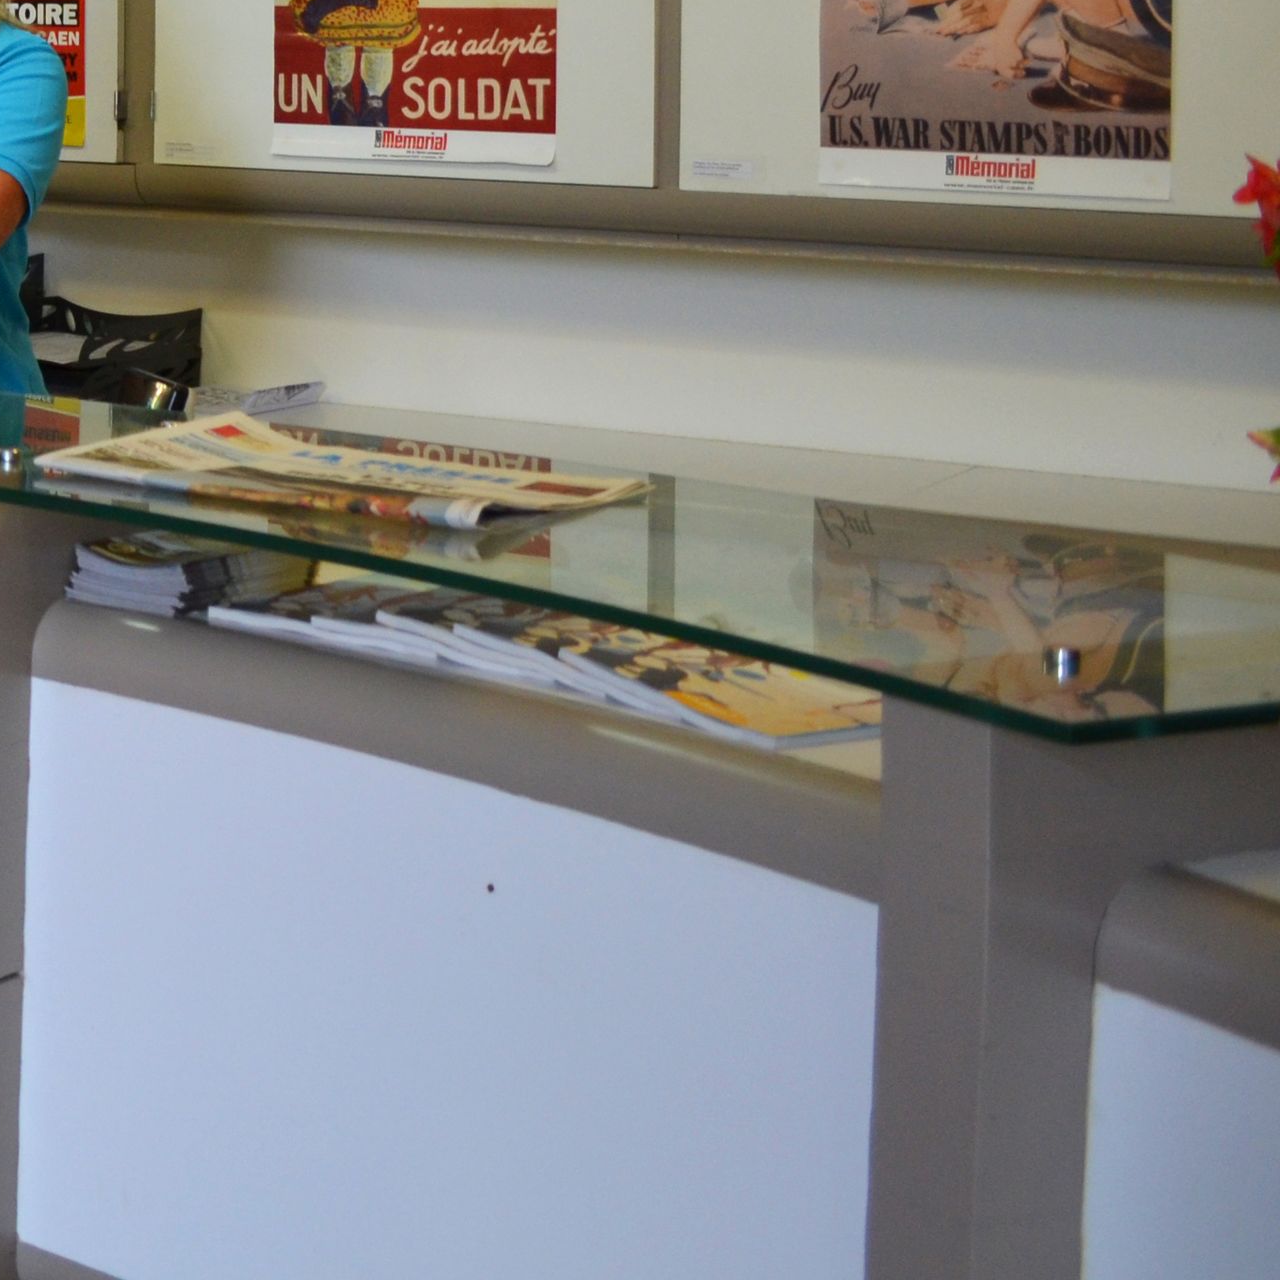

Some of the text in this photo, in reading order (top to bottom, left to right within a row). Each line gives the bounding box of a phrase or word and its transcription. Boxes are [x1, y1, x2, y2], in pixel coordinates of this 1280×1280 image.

[7, 3, 78, 25] TOIRE
[278, 73, 551, 121] UN SOLDAT
[820, 64, 881, 112] Buy
[382, 130, 448, 151] Mémorial
[871, 117, 930, 150] WAR
[939, 120, 1048, 156] STAMPS
[1073, 124, 1171, 159] BONDS
[955, 155, 1036, 179] Mémorial
